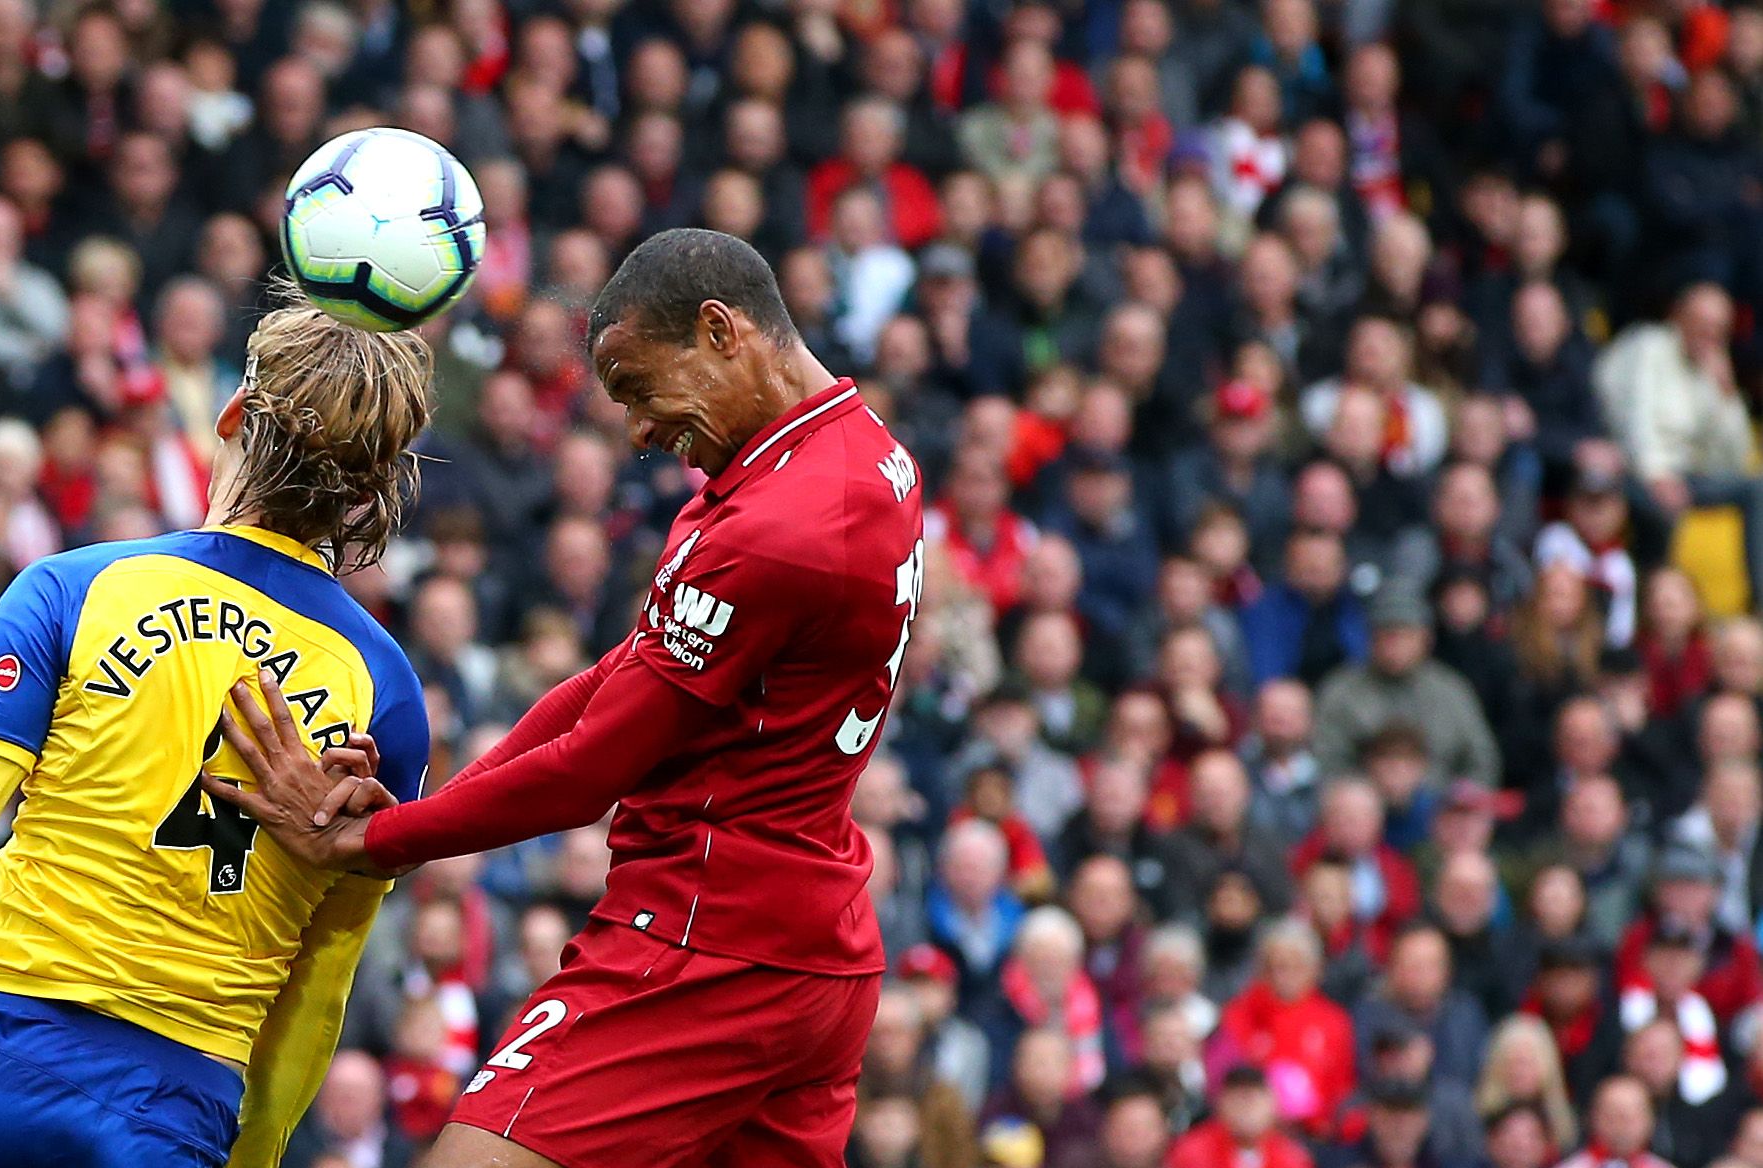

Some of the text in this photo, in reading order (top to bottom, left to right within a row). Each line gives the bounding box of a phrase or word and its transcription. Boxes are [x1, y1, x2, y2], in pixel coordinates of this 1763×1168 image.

[663, 615, 714, 654] Wstern
[673, 582, 735, 637] WU
[84, 597, 352, 754] VESTERGAAR
[663, 633, 705, 671] Union
[152, 700, 261, 895] 4
[486, 999, 568, 1071] 2
